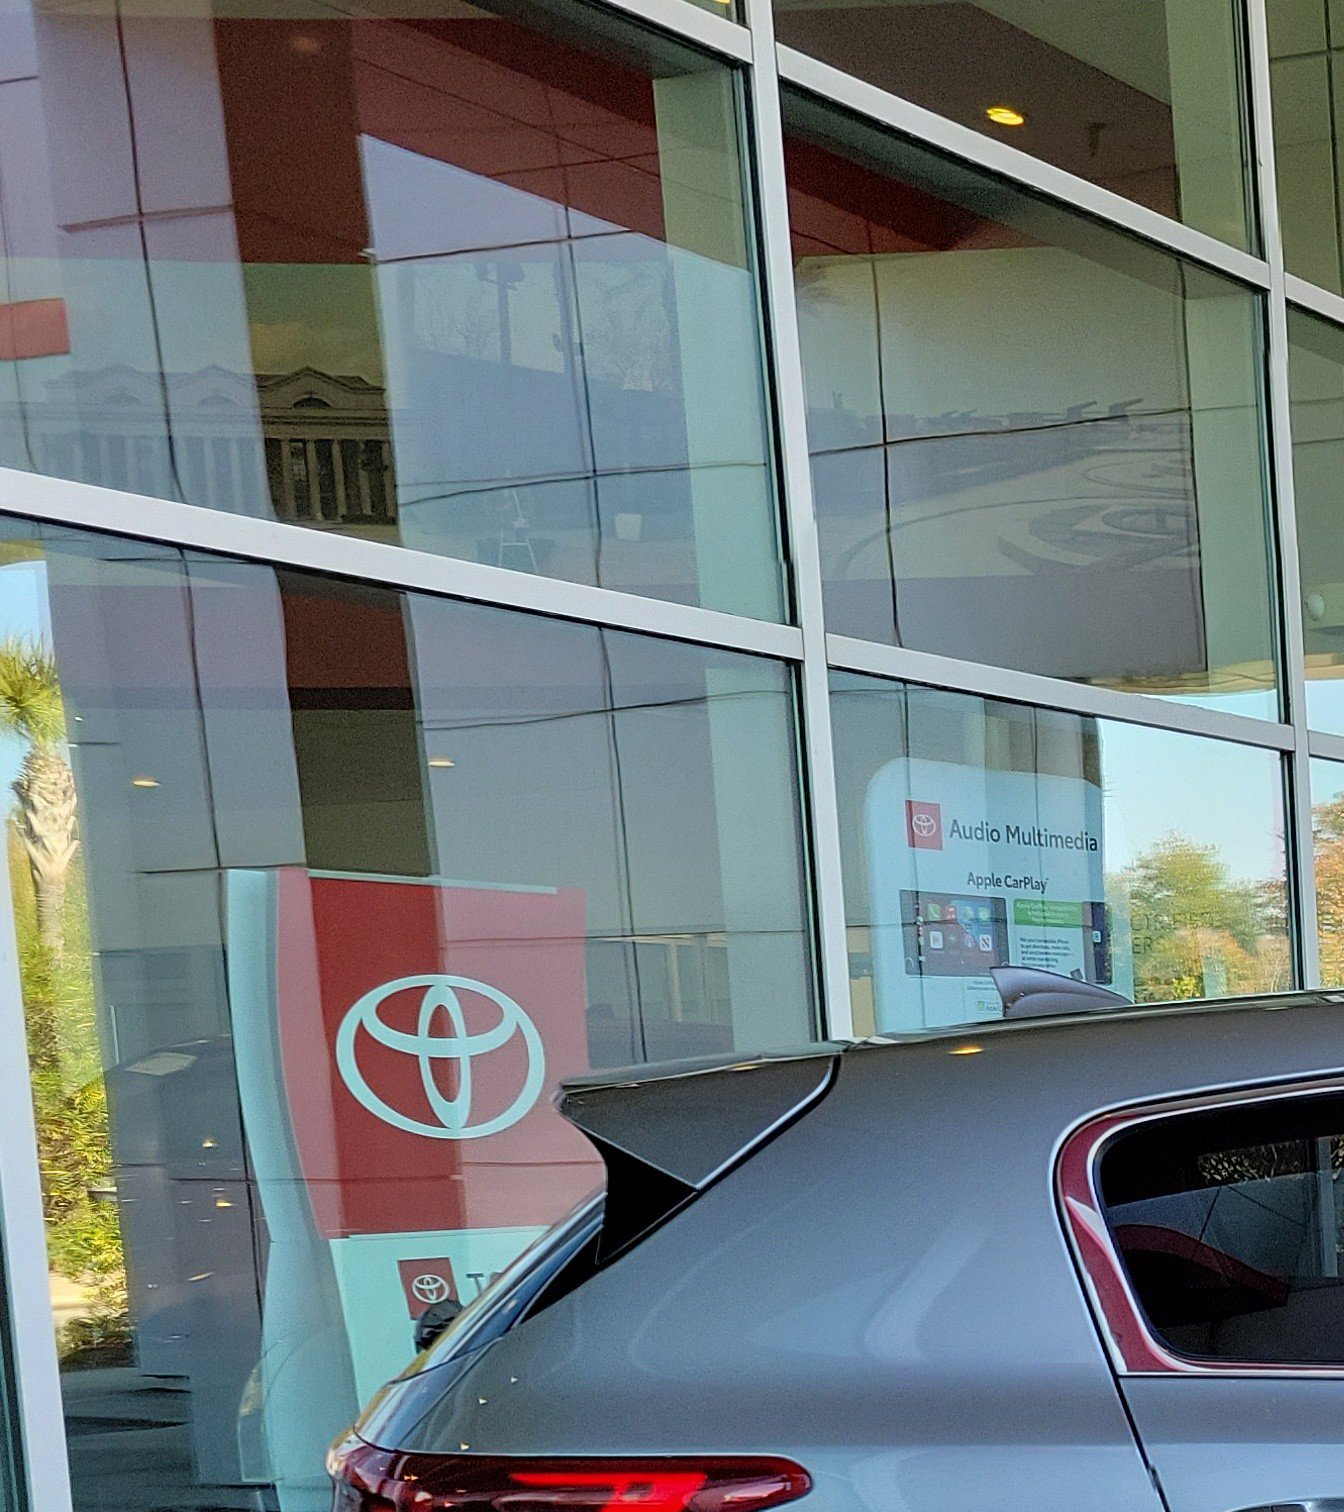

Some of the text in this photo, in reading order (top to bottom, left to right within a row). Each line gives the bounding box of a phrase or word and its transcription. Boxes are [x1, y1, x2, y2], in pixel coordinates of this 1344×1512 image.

[949, 818, 1098, 851] Audio Multimedia
[967, 871, 1047, 895] Apple CarPlay
